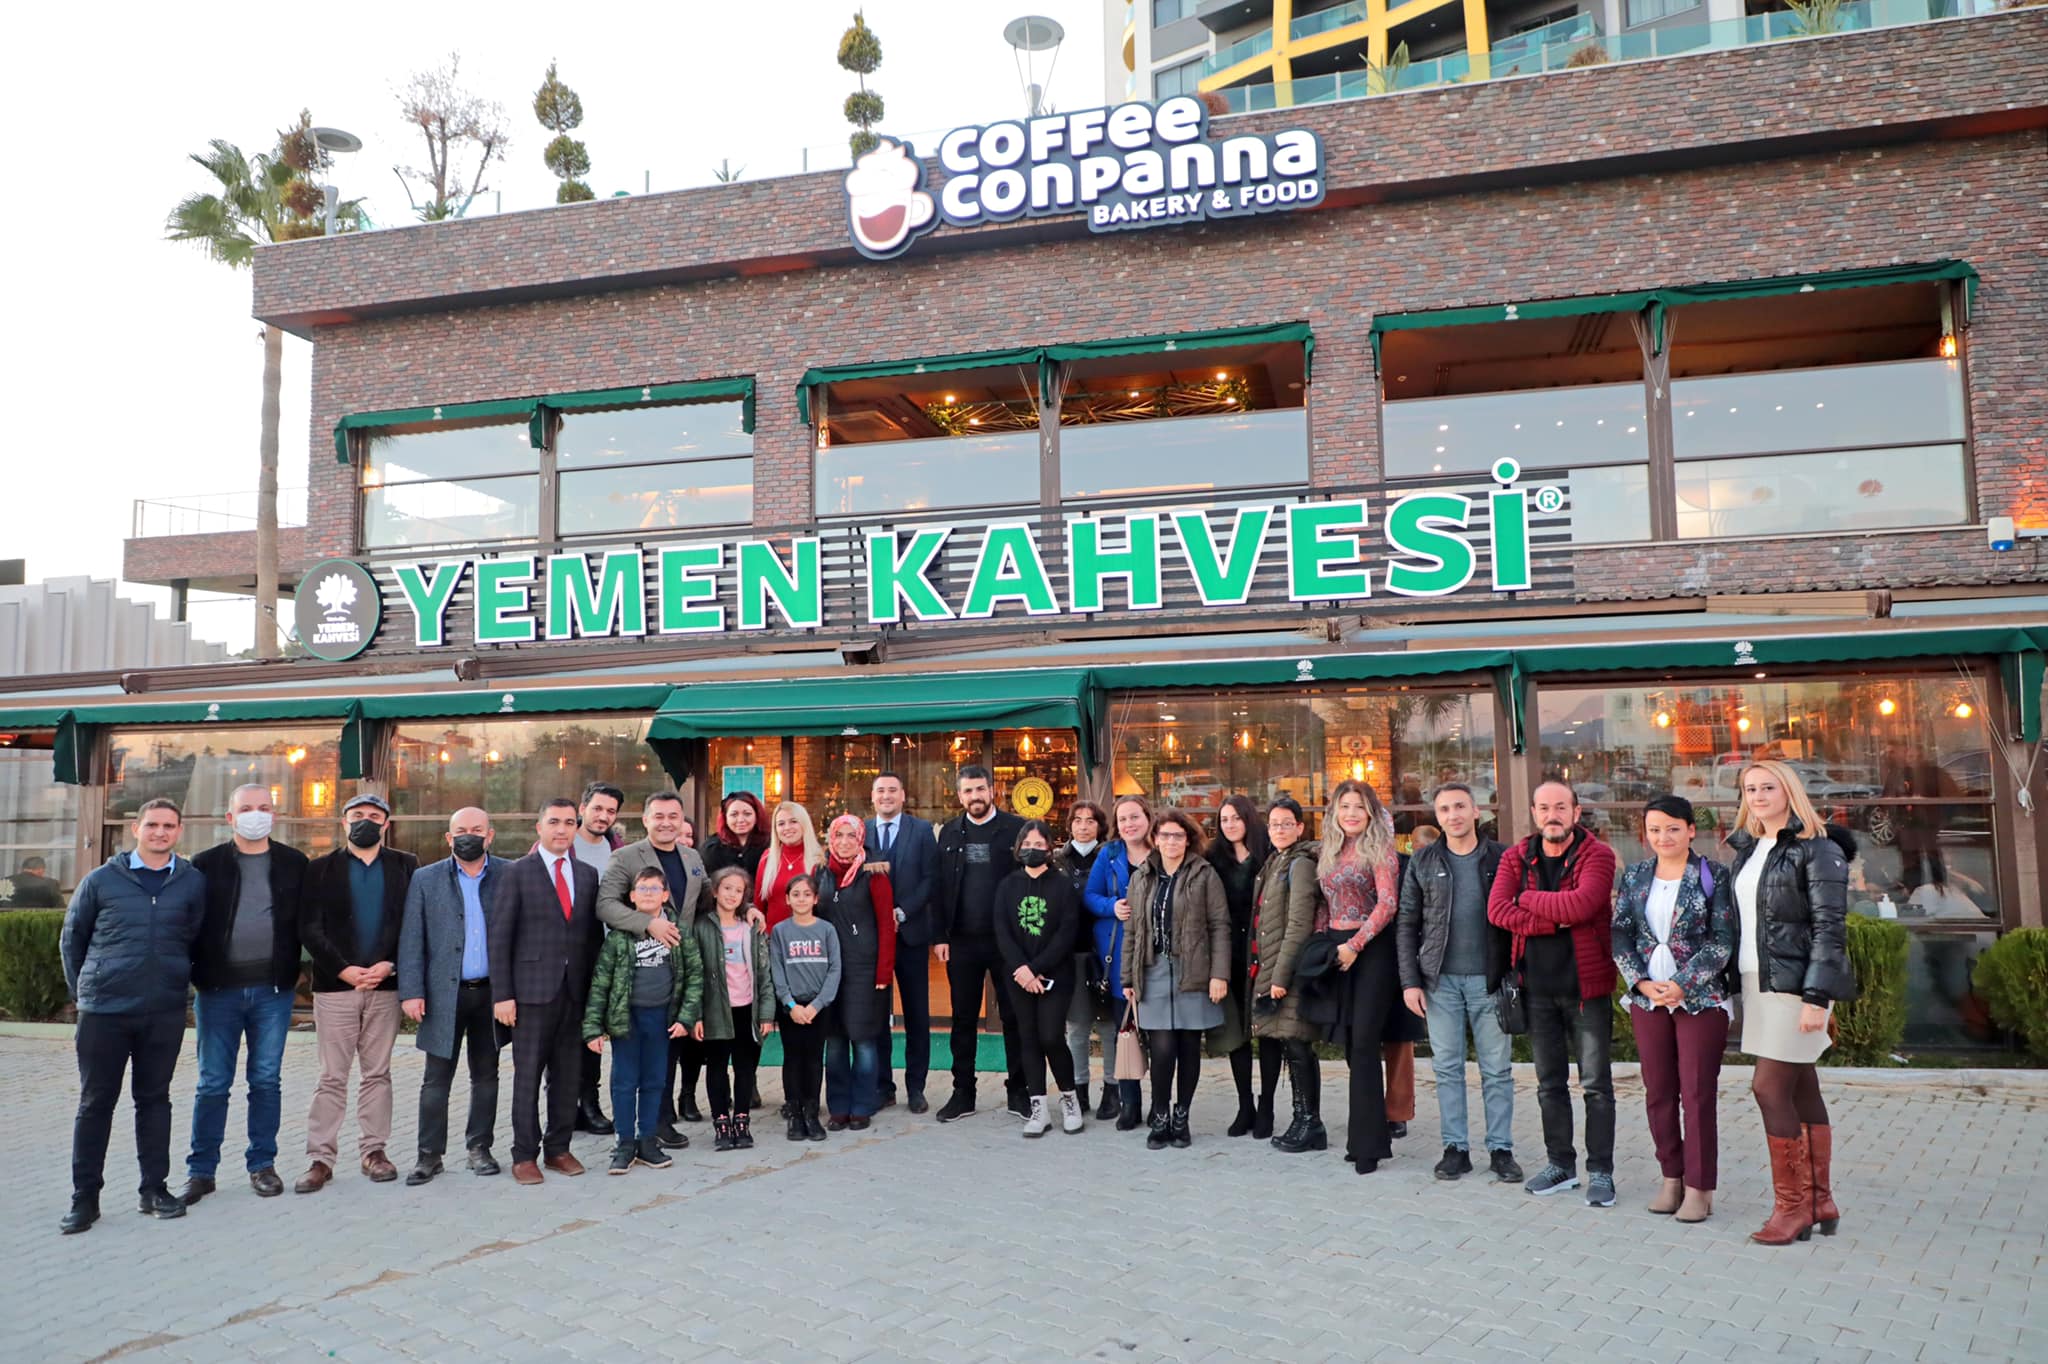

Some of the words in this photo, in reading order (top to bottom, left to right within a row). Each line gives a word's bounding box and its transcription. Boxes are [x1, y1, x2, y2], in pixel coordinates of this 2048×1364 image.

[1093, 192, 1203, 225] BAKERY
[1213, 189, 1232, 210] &
[1240, 178, 1319, 206] FOOD
[392, 536, 823, 647] YEMEN
[866, 457, 1532, 624] KAHVESİ
[789, 945, 822, 957] STYLE
